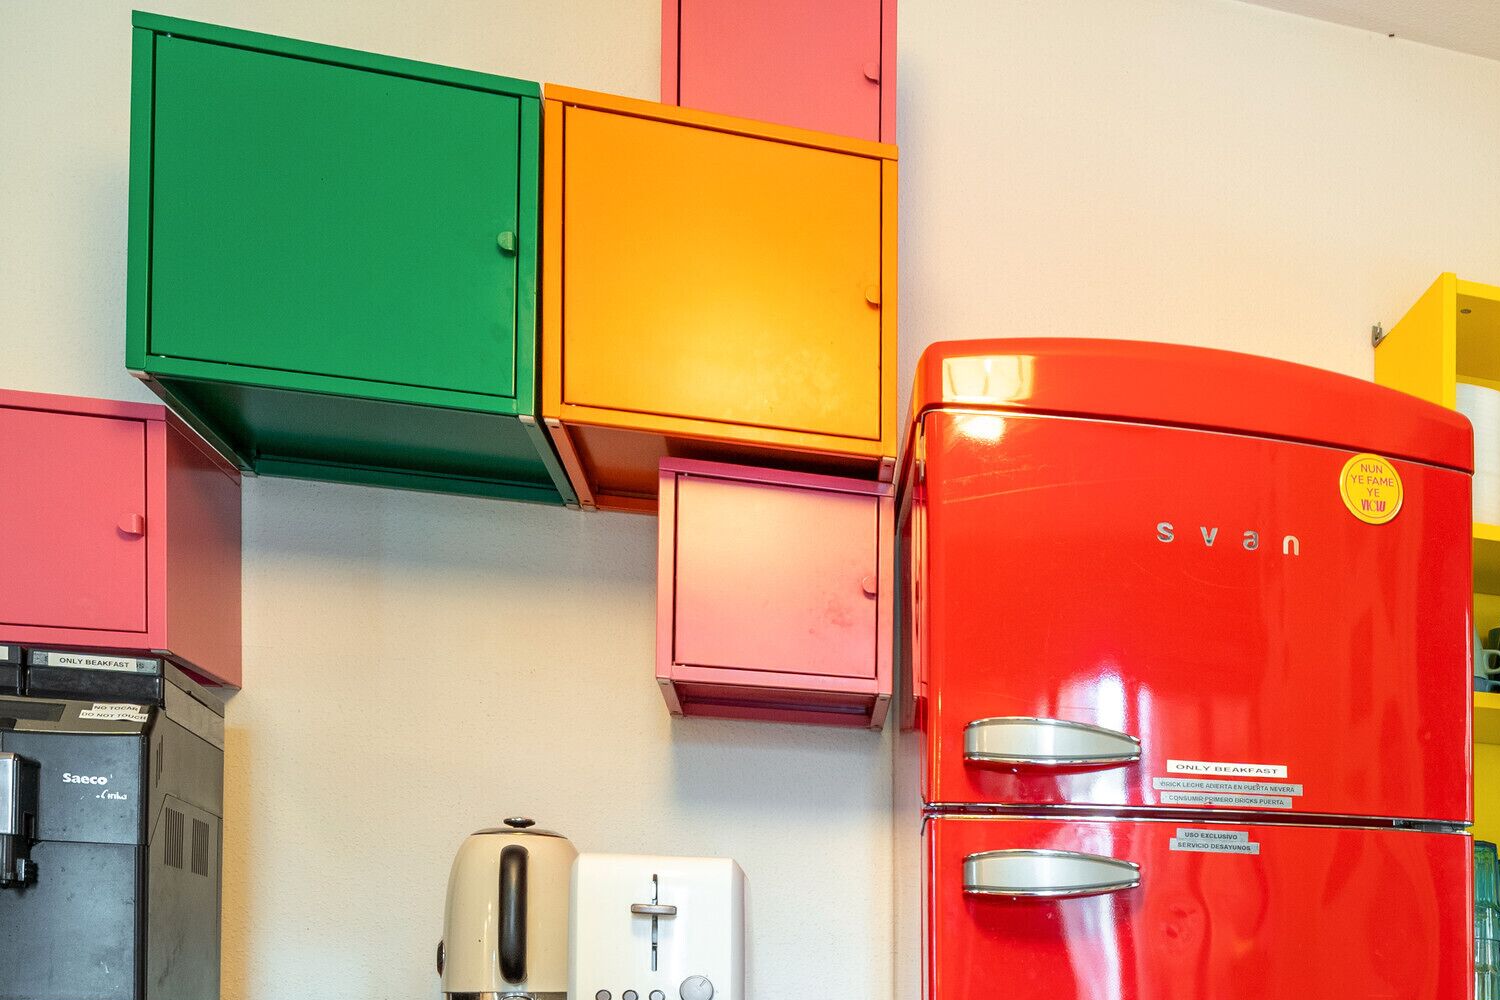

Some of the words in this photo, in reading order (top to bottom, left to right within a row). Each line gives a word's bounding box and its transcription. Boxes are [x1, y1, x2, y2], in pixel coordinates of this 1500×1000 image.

[1360, 463, 1383, 474] NUN
[1351, 474, 1364, 484] YE
[1367, 476, 1394, 487] FAME
[1367, 488, 1380, 497] YE
[1156, 521, 1300, 556] svan
[59, 657, 83, 665] ONLY
[85, 659, 130, 668] BEAKFAST
[1175, 763, 1210, 771] ONLY
[1214, 766, 1279, 775] BEAKFAST
[62, 772, 108, 786] Saeco
[1200, 832, 1238, 840] EXCLUSIVO
[1210, 843, 1251, 851] DESAYUNOS
